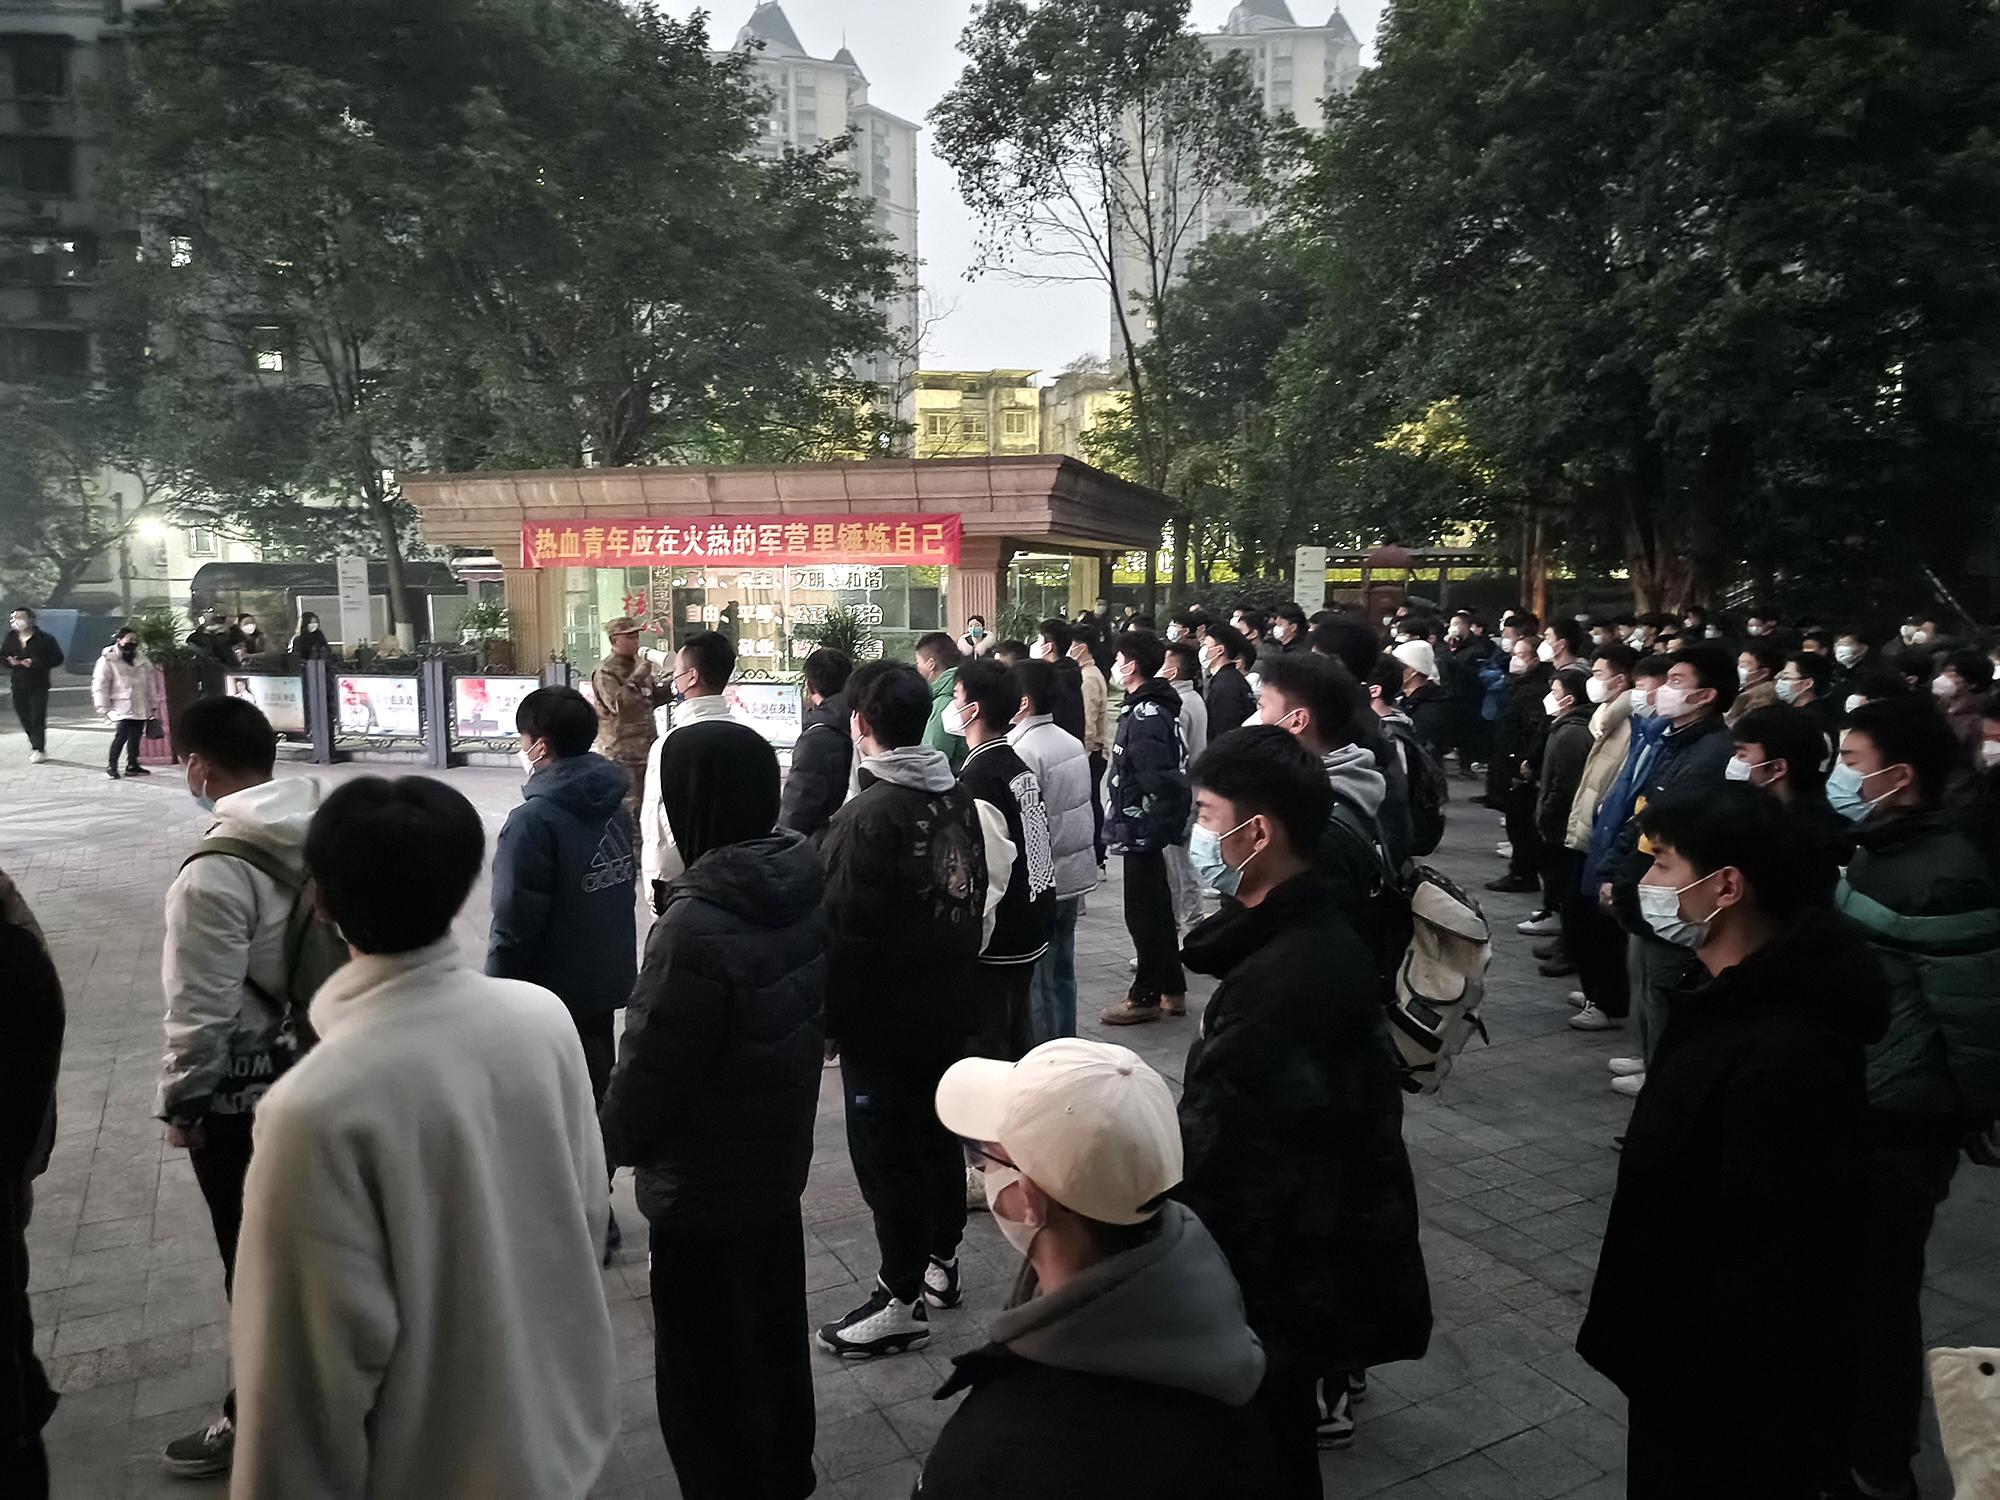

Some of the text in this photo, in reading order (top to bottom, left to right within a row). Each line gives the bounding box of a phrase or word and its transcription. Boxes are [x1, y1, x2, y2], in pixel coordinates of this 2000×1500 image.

[535, 522, 945, 559] 热血青年应在火热的军营里锤炼自己
